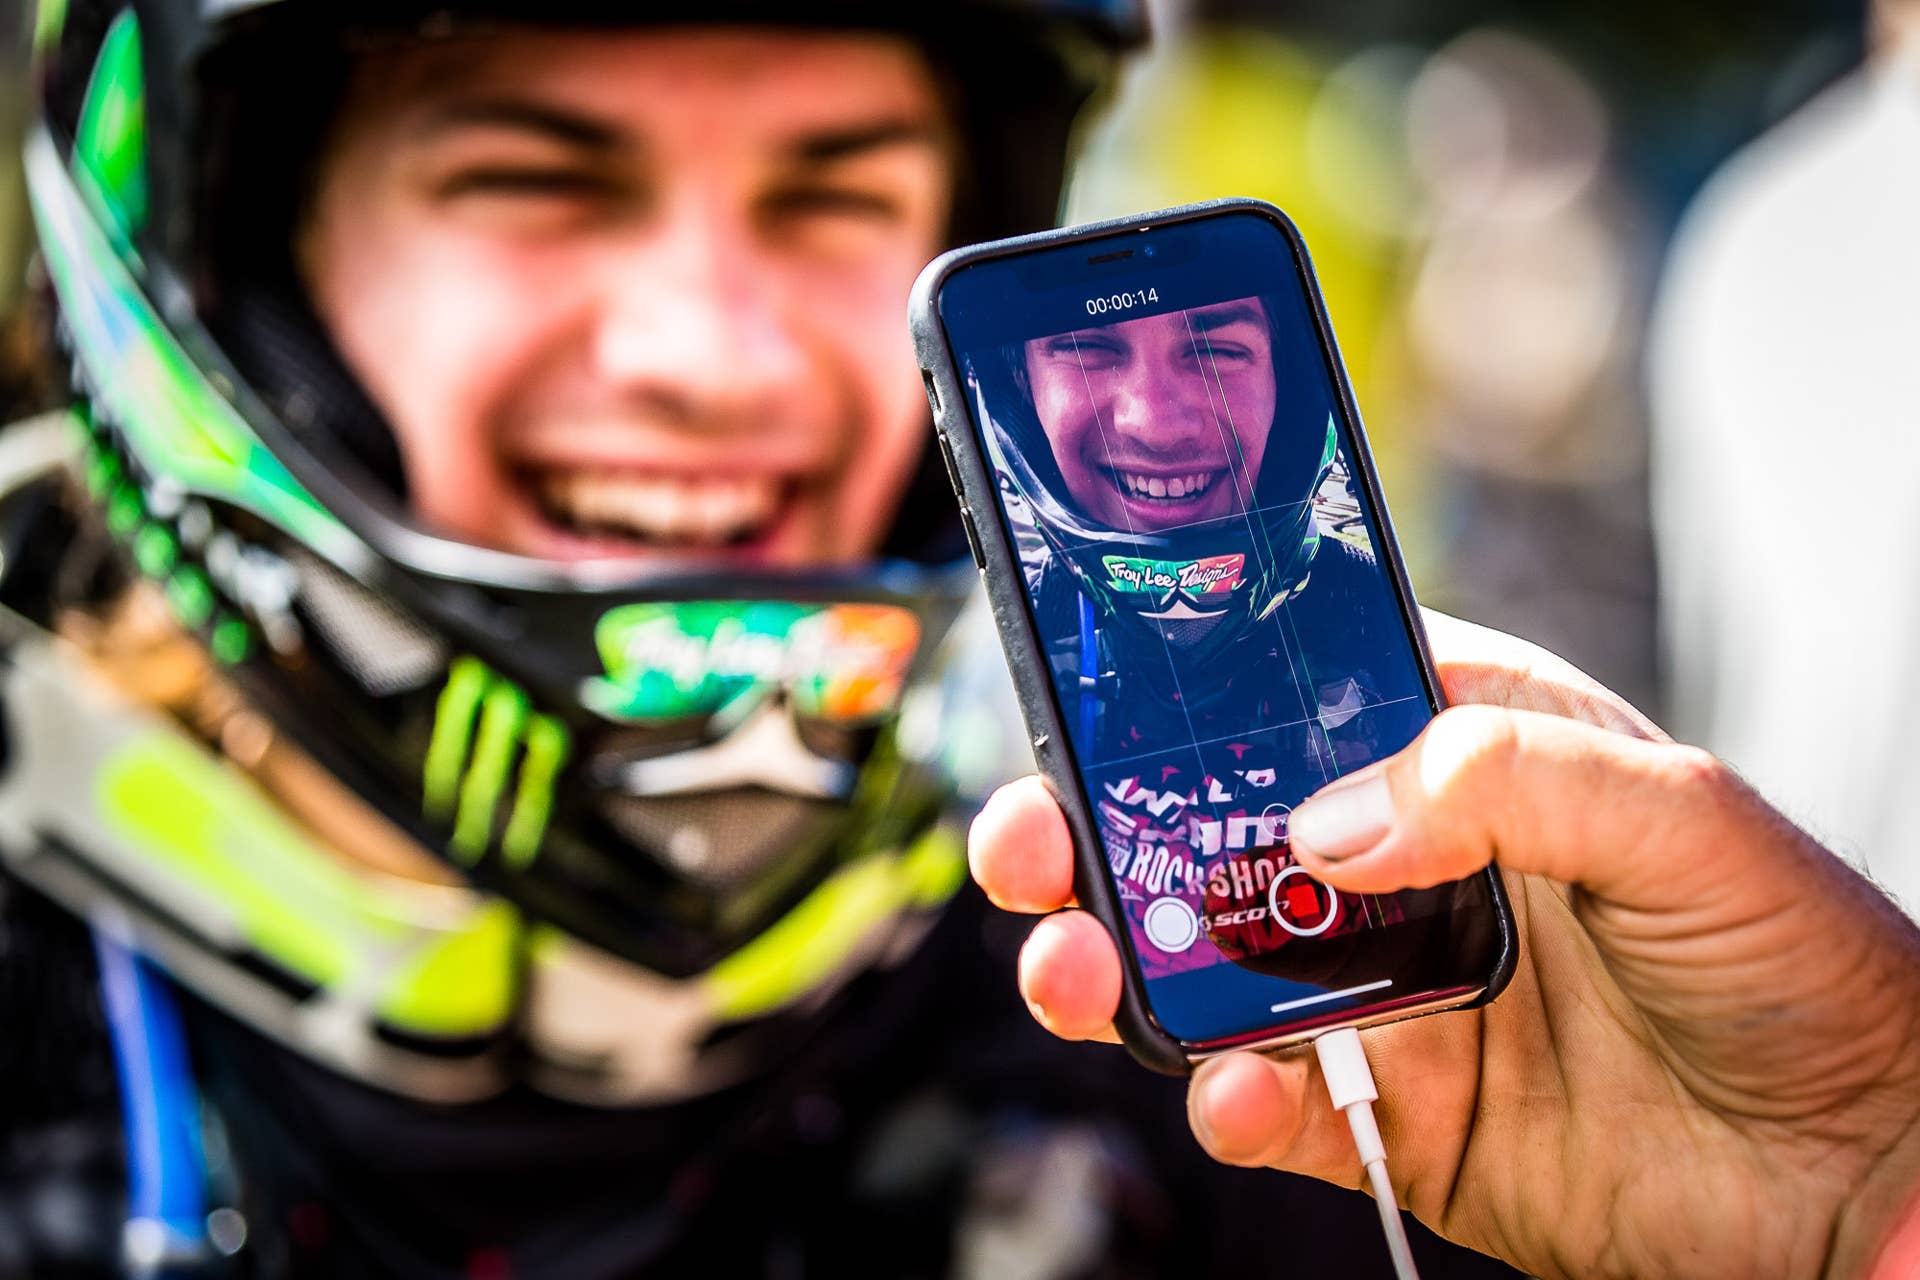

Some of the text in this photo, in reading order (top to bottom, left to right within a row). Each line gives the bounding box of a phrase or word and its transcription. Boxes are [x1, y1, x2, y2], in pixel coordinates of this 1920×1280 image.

[1086, 287, 1159, 315] 00:00:14
[1111, 557, 1239, 591] Troy Lee Designs
